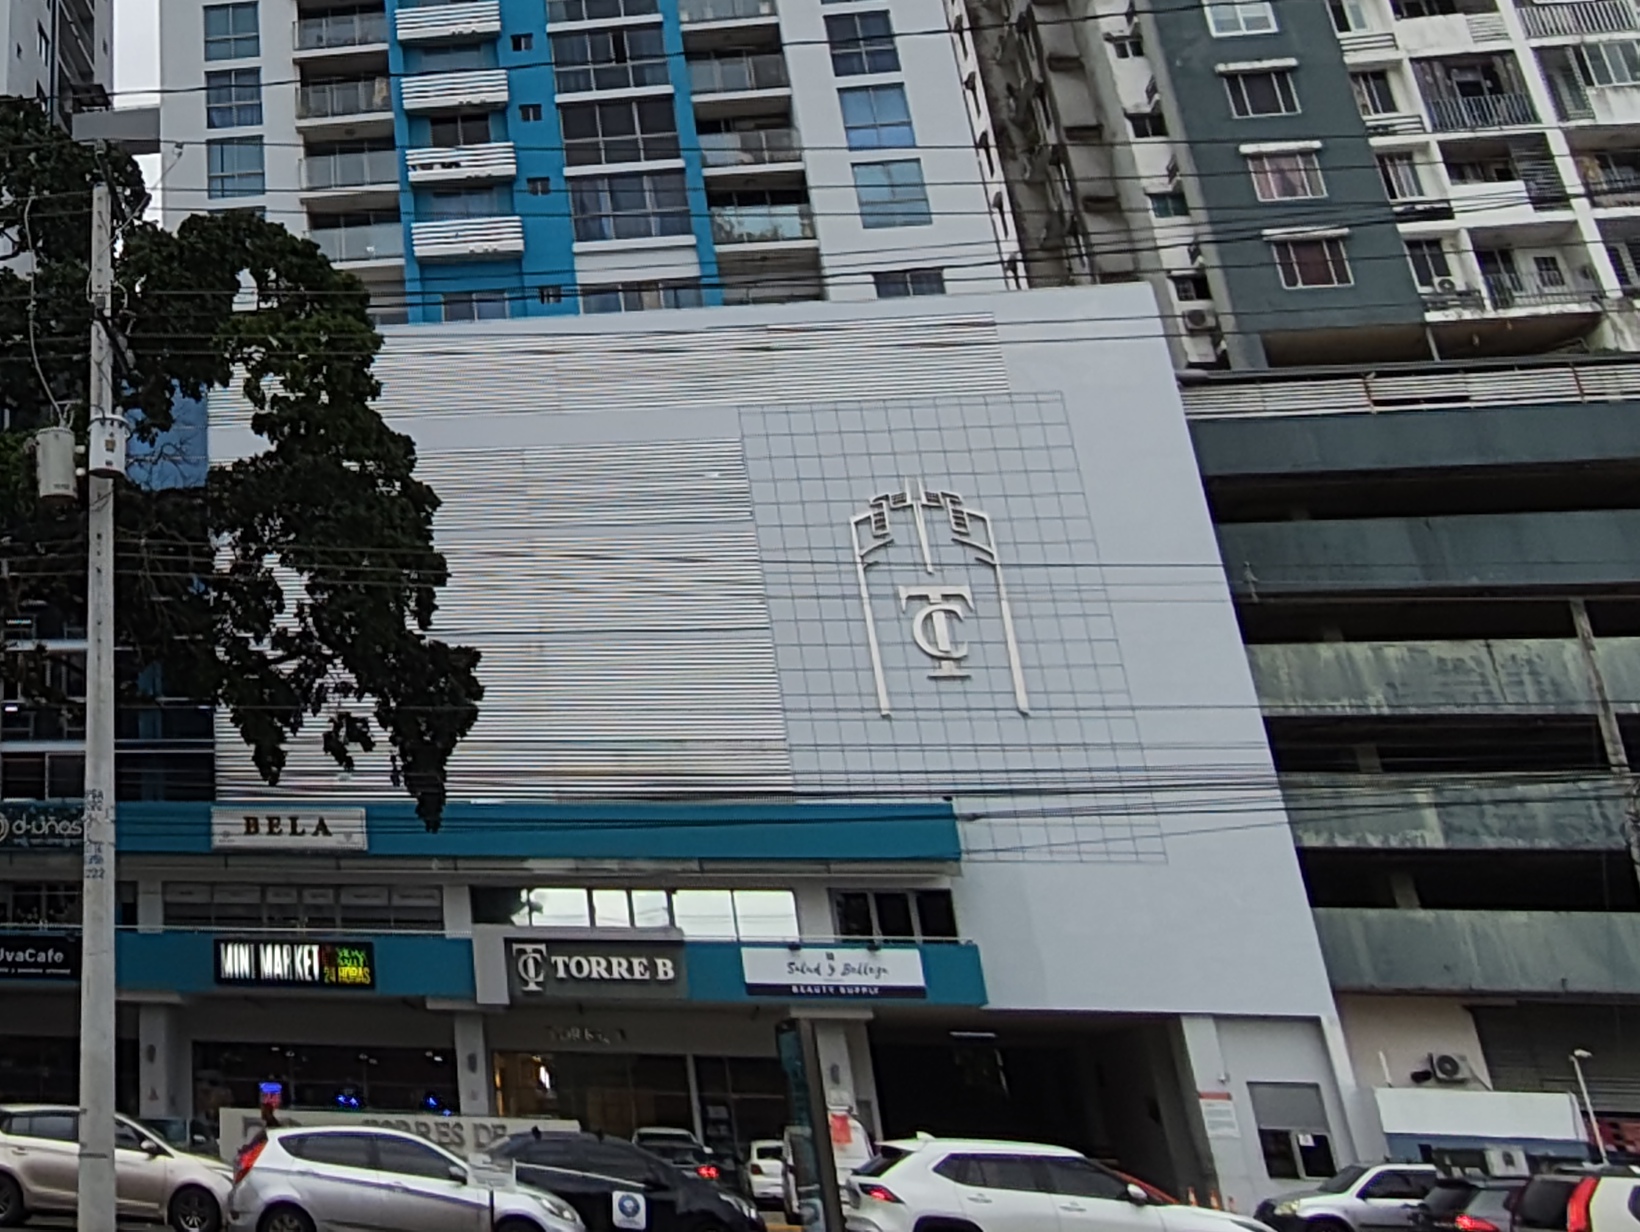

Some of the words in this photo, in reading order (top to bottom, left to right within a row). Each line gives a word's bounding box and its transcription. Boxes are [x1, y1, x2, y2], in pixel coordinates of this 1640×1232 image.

[242, 816, 333, 837] BELA
[219, 942, 256, 980] MINI
[259, 943, 320, 981] MARKET
[551, 955, 650, 980] TORRE
[656, 958, 675, 981] B
